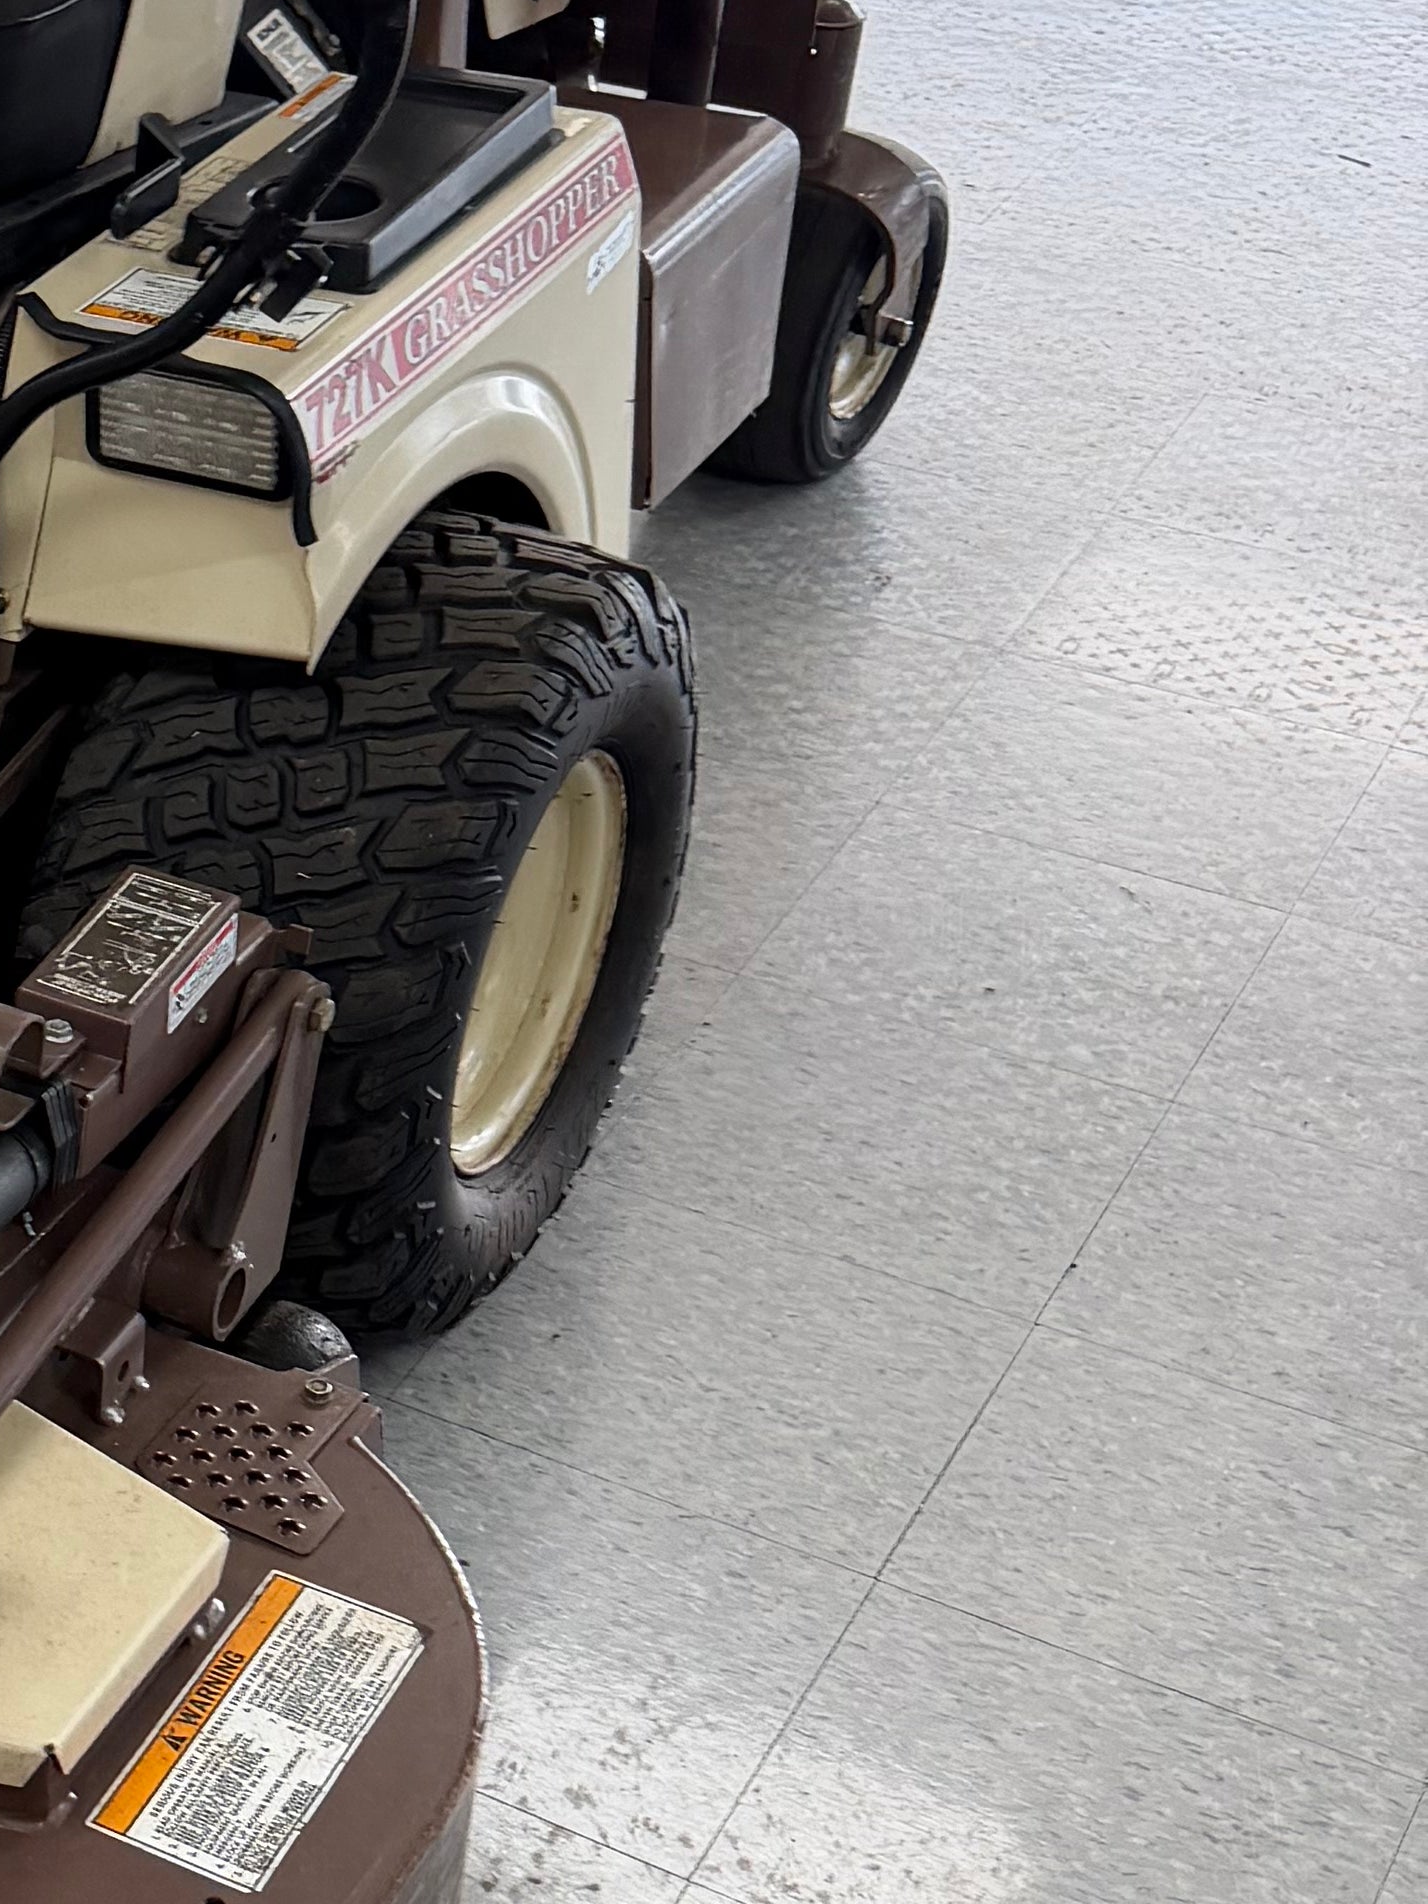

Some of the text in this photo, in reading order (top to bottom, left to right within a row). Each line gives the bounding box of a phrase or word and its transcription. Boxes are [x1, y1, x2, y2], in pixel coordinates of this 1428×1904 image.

[305, 331, 398, 453] 727K
[402, 153, 623, 365] GRASSHOPPER
[173, 1753, 201, 1783] INJURY
[194, 1735, 214, 1754] CAN
[227, 1682, 252, 1707] FROM
[174, 1647, 247, 1728] WARNING
